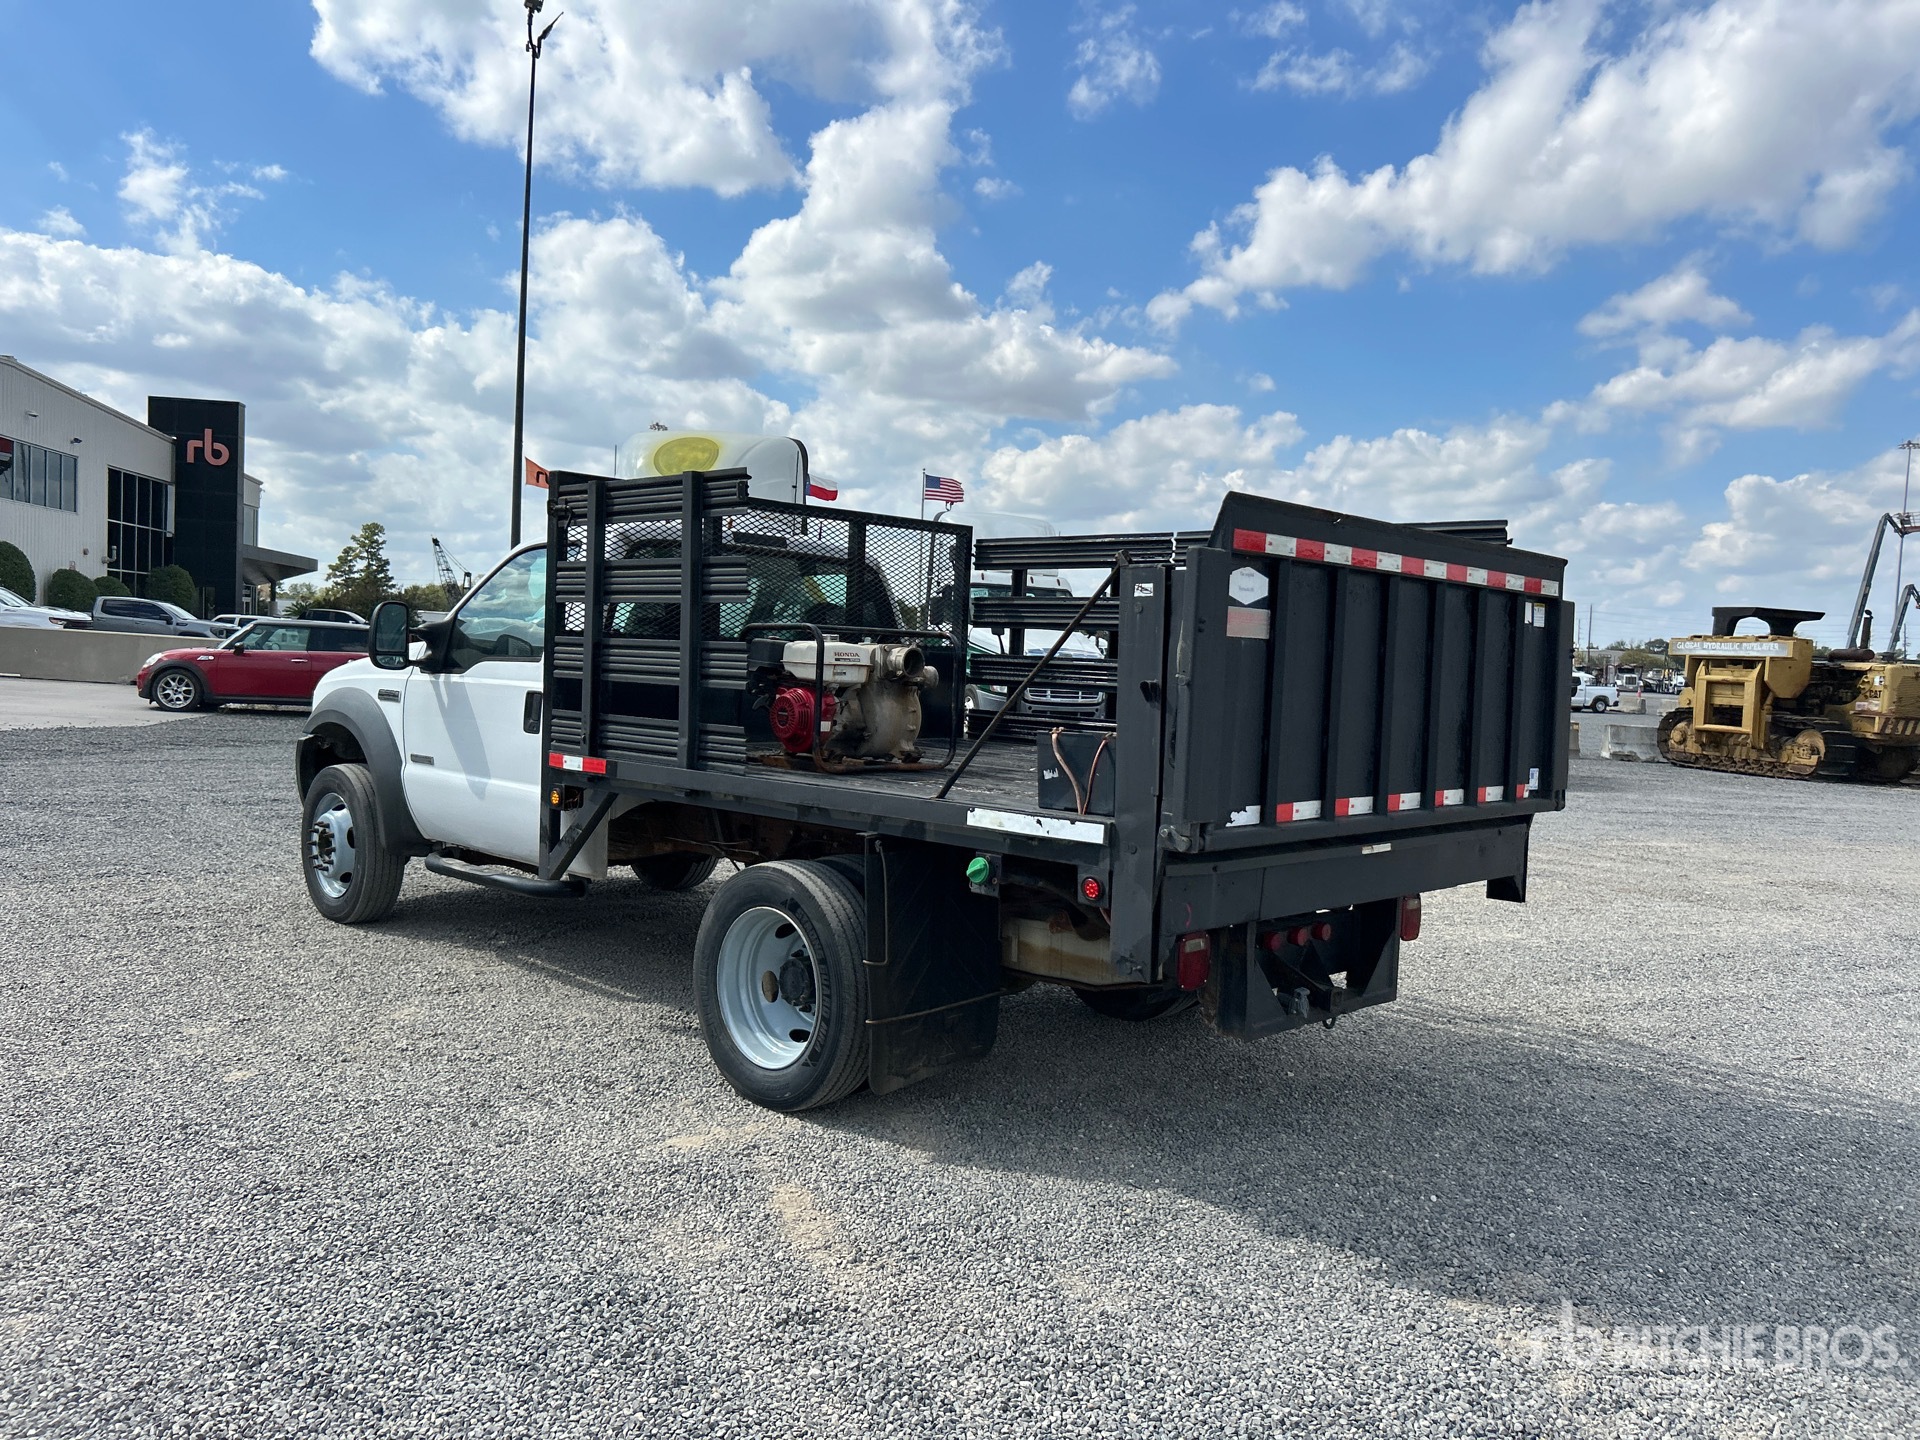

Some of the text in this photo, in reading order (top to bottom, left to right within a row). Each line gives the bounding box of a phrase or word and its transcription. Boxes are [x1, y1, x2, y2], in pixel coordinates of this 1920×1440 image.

[186, 428, 230, 466] rb
[1703, 642, 1739, 650] HYDRAULIC
[1742, 642, 1779, 651] PIPELAYER
[1869, 690, 1882, 698] CAT
